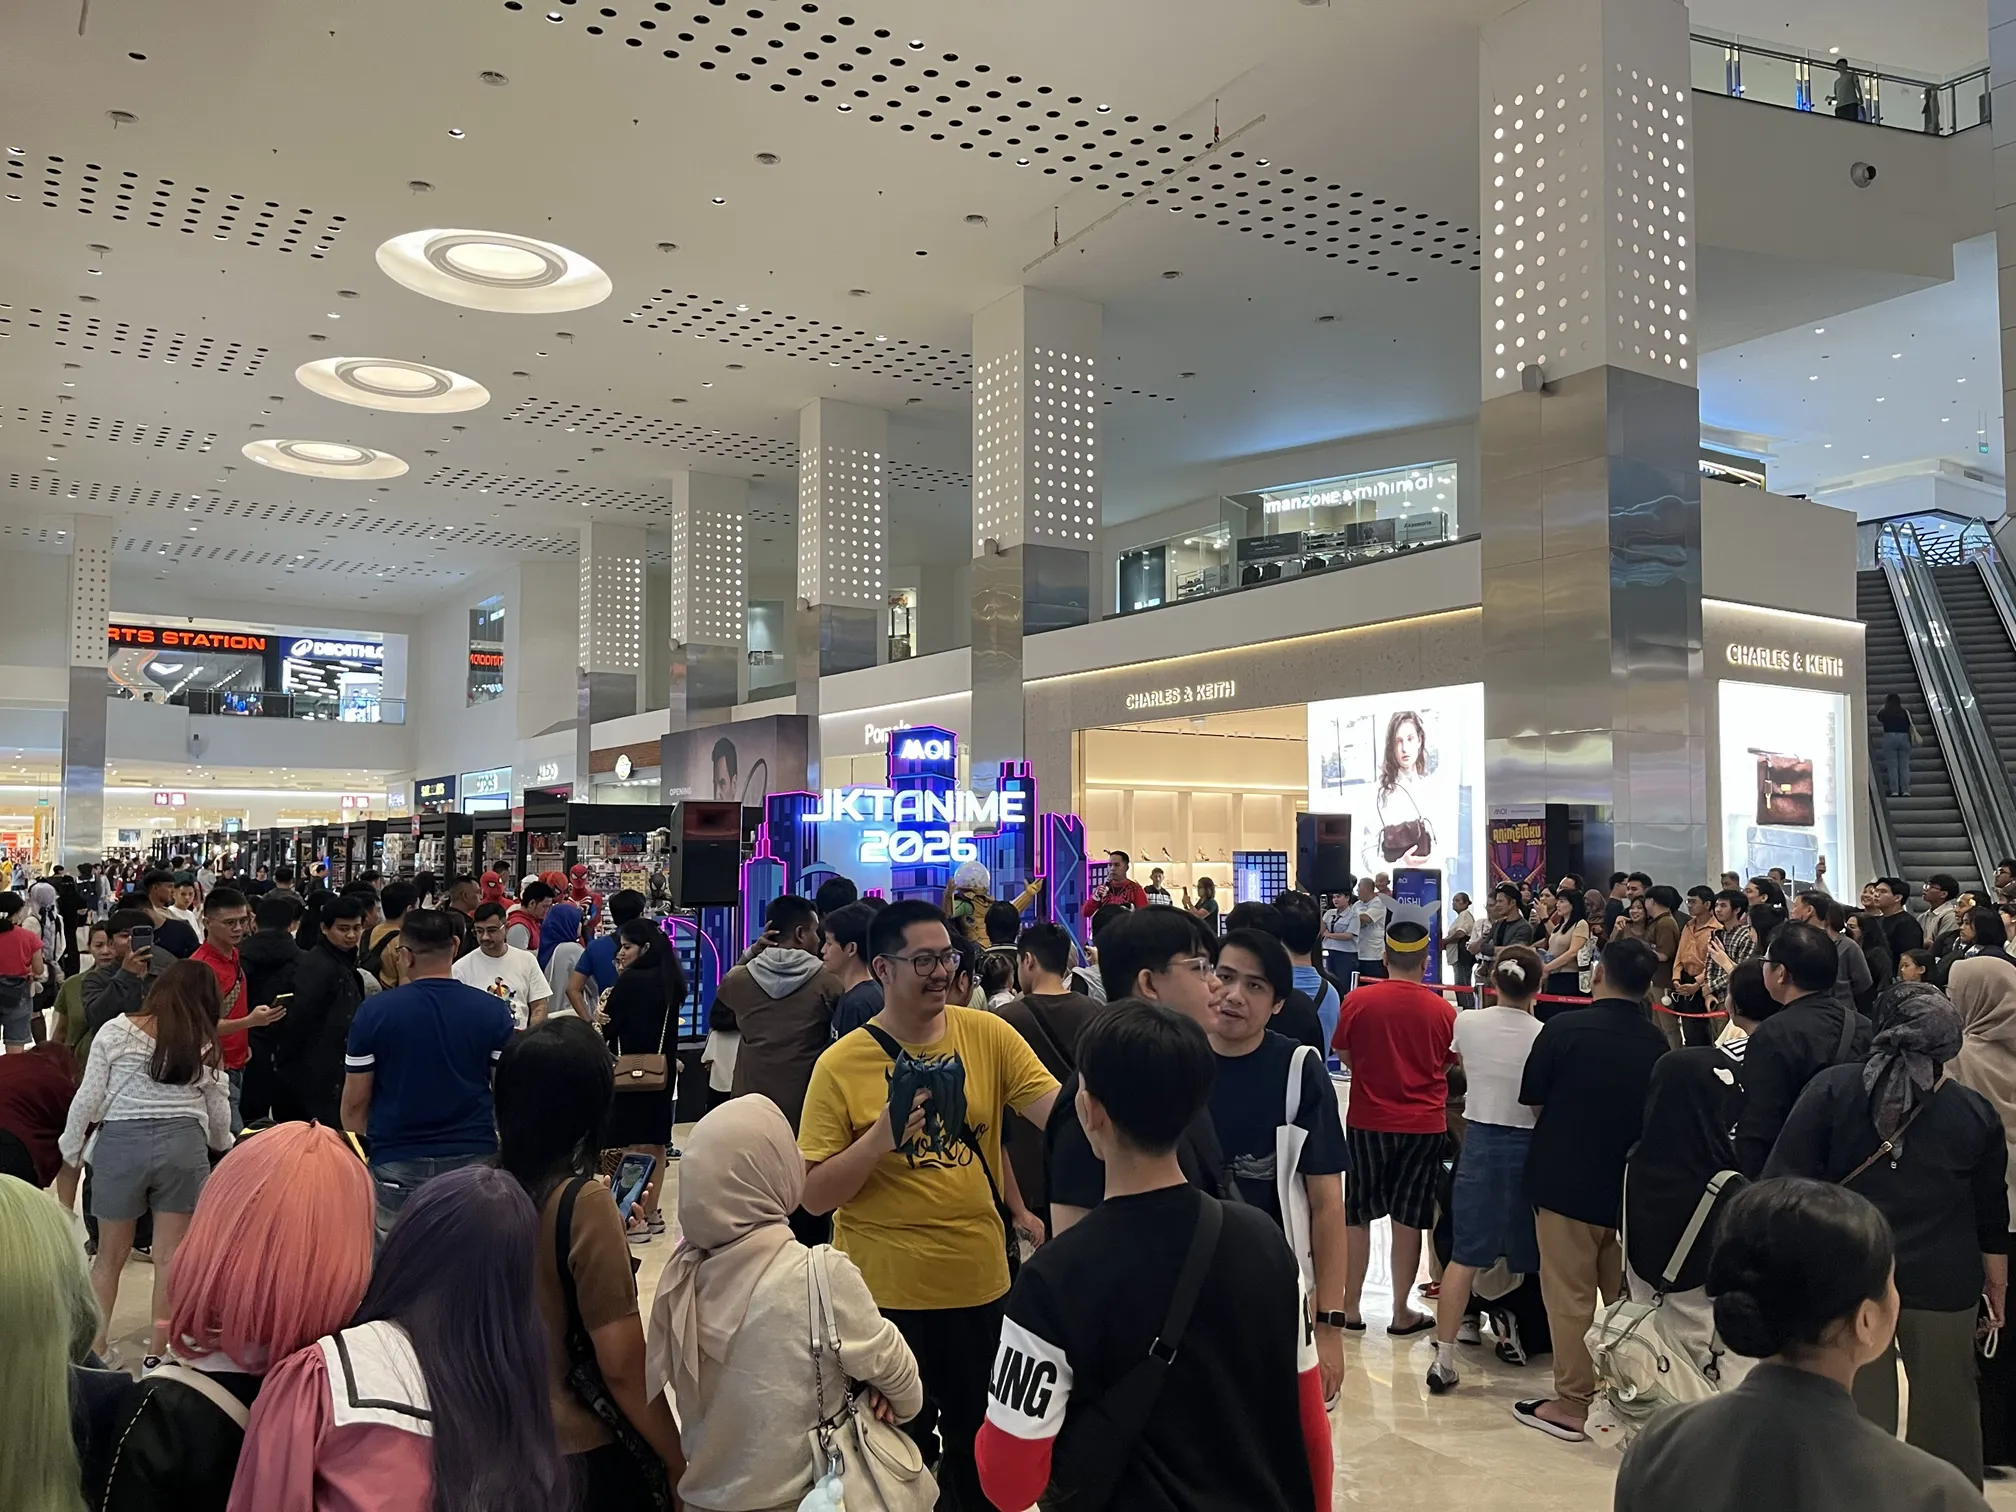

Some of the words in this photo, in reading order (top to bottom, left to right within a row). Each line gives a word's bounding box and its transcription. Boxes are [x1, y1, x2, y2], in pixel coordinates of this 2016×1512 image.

[1355, 473, 1433, 500] minimal
[162, 631, 266, 650] STATION
[1726, 643, 1790, 670] CHARLES
[1793, 651, 1804, 672] &
[1805, 653, 1843, 676] KEITH
[1126, 687, 1181, 710] CHARLES
[1183, 686, 1193, 702] &
[1196, 680, 1236, 701] KEITH
[901, 738, 950, 760] MOI
[801, 788, 1027, 823] JKTANIME
[860, 830, 978, 863] 2026
